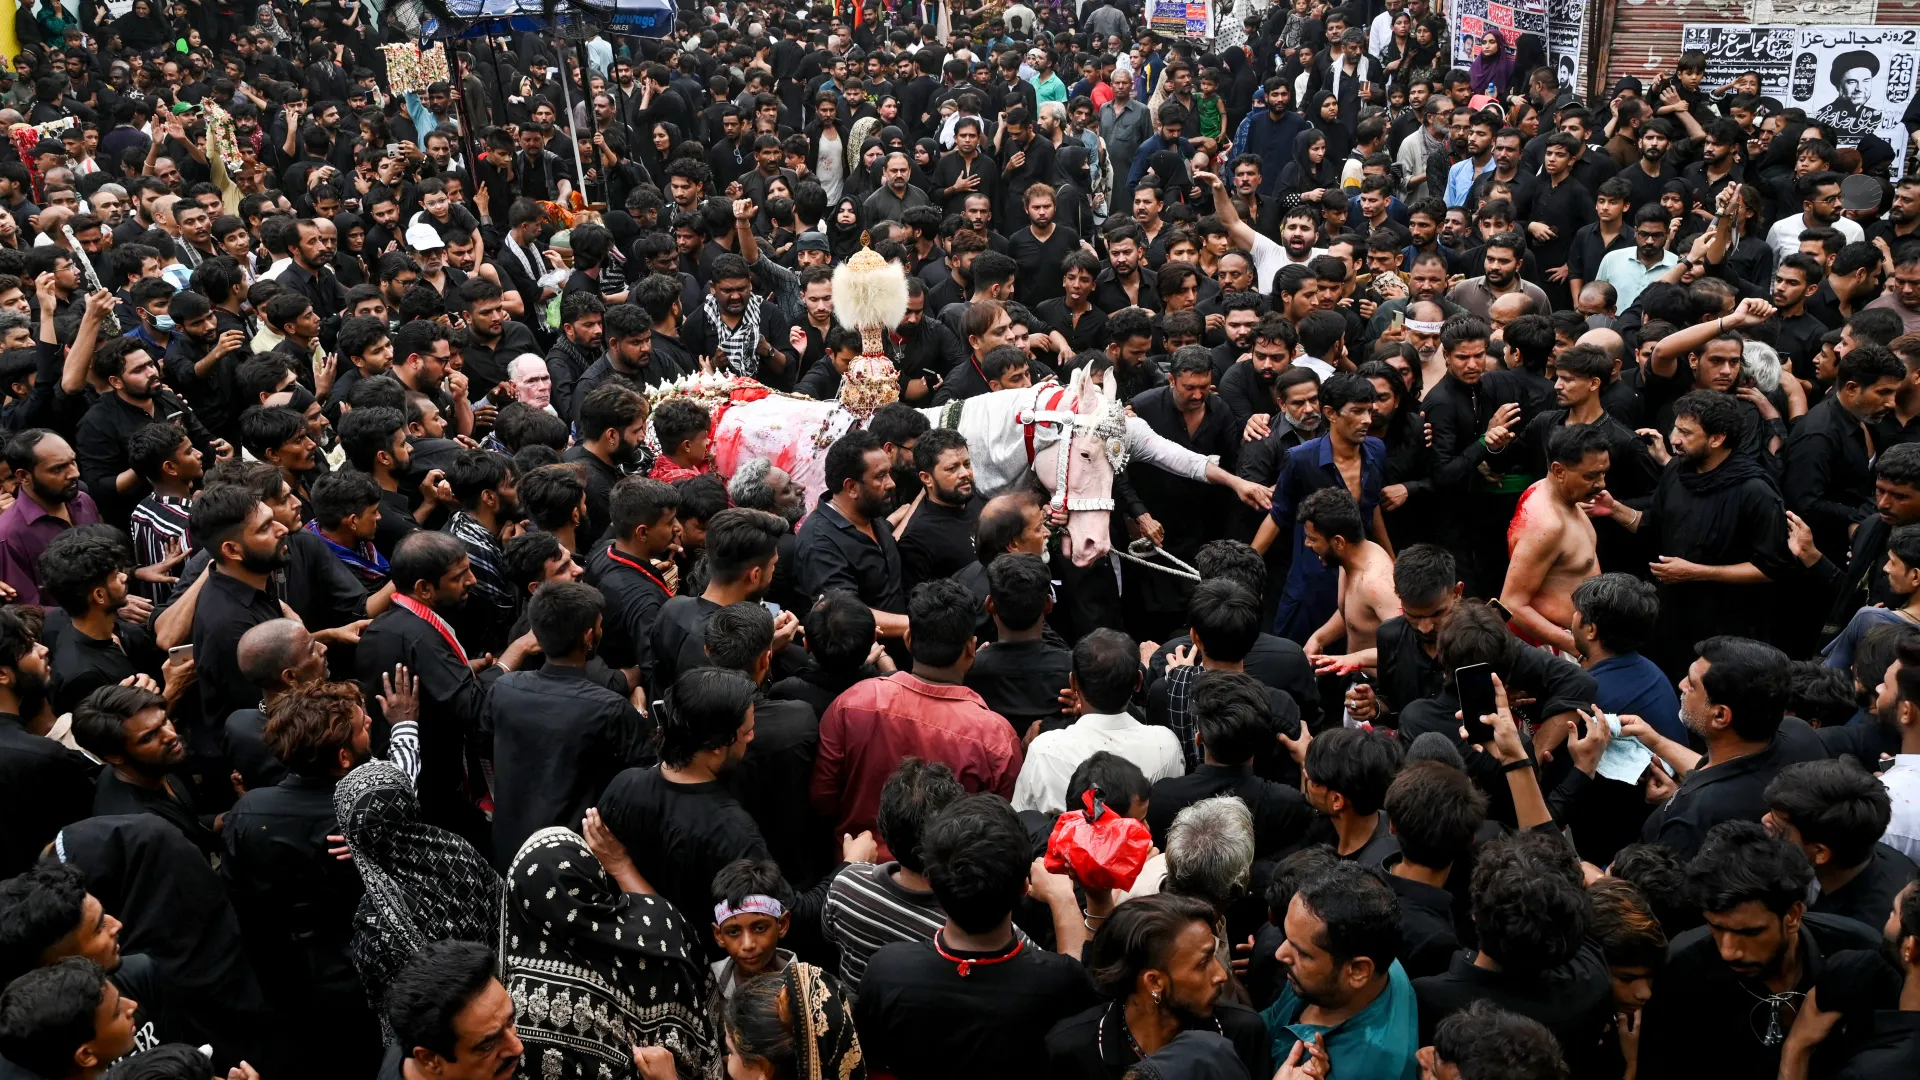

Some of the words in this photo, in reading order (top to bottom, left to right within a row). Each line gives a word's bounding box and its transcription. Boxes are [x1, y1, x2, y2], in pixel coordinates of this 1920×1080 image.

[612, 13, 655, 29] newage
[1688, 28, 1697, 39] 3
[1699, 28, 1709, 39] 4
[1769, 29, 1781, 39] 27
[1782, 29, 1794, 39] 28
[1800, 32, 1824, 48] عزا
[1823, 31, 1882, 48] مجالس
[1902, 30, 1916, 44] 2
[1890, 55, 1913, 70] 25
[1889, 69, 1911, 83] 26
